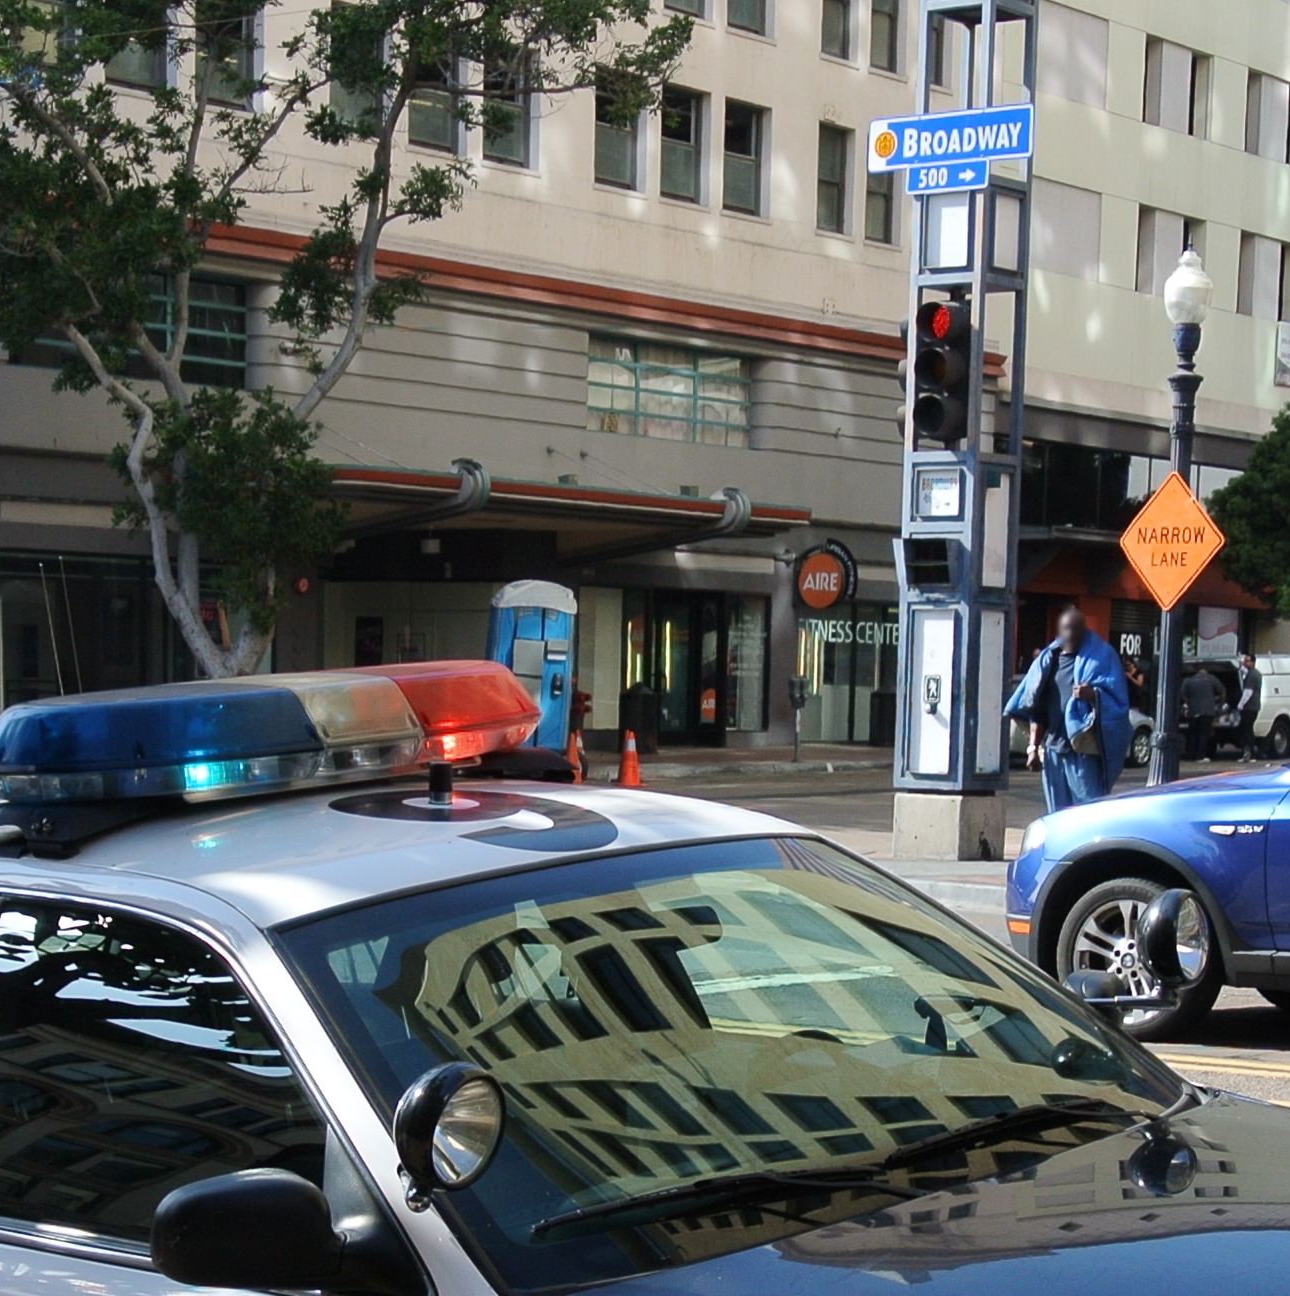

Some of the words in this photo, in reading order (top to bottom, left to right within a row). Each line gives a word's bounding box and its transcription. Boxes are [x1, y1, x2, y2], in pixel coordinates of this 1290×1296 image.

[903, 122, 1022, 158] BROADWAY
[918, 167, 948, 189] 500
[1137, 526, 1206, 545] NARROW
[1150, 551, 1188, 567] LANE
[803, 572, 839, 592] AIRE
[799, 618, 853, 643] FITNESS
[856, 621, 900, 645] CENTE
[1120, 633, 1142, 656] FOR
